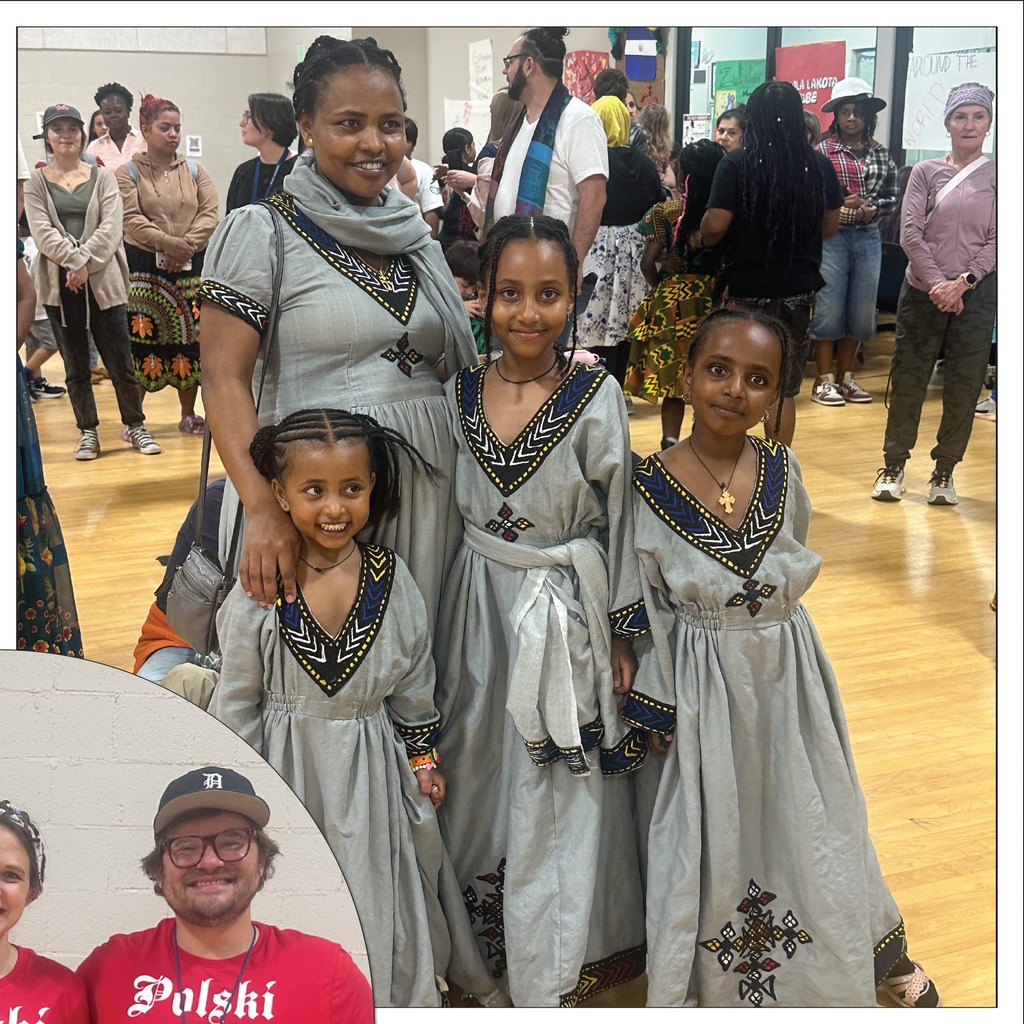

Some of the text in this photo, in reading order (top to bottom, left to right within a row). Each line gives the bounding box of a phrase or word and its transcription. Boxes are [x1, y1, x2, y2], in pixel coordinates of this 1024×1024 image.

[908, 54, 978, 79] AROUND THE
[806, 76, 838, 90] LAKOTA
